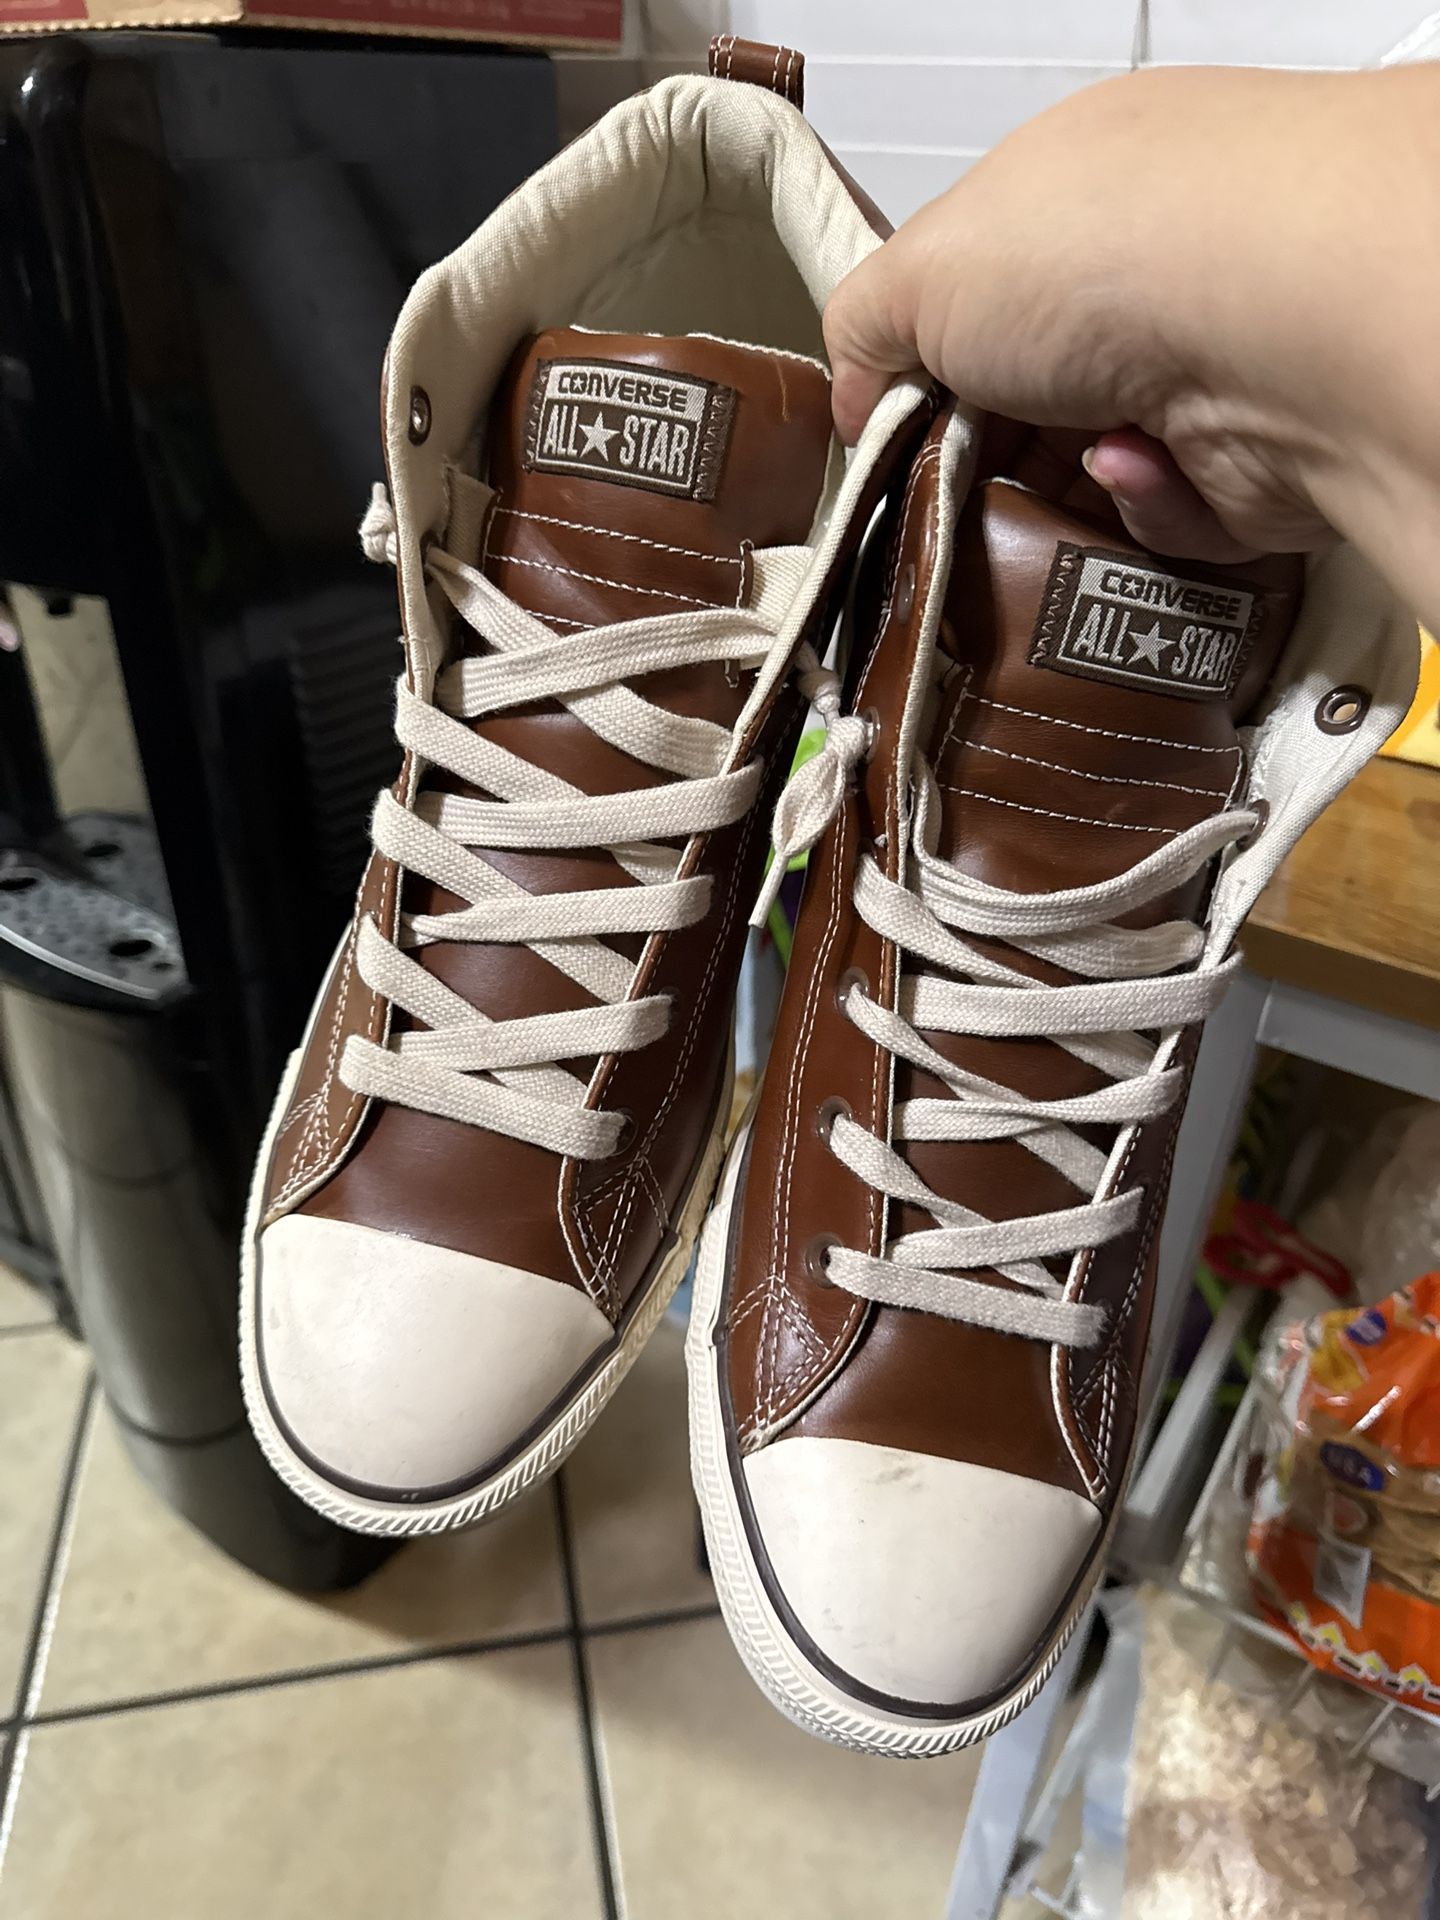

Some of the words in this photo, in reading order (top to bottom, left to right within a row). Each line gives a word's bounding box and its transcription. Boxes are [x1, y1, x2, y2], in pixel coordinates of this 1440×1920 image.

[557, 371, 689, 413] CONVERSE
[543, 404, 580, 458] ALL
[618, 414, 691, 477] STAR
[1100, 568, 1243, 622] CONVERSE
[1071, 603, 1132, 665] ALL
[1170, 624, 1237, 683] STAR
